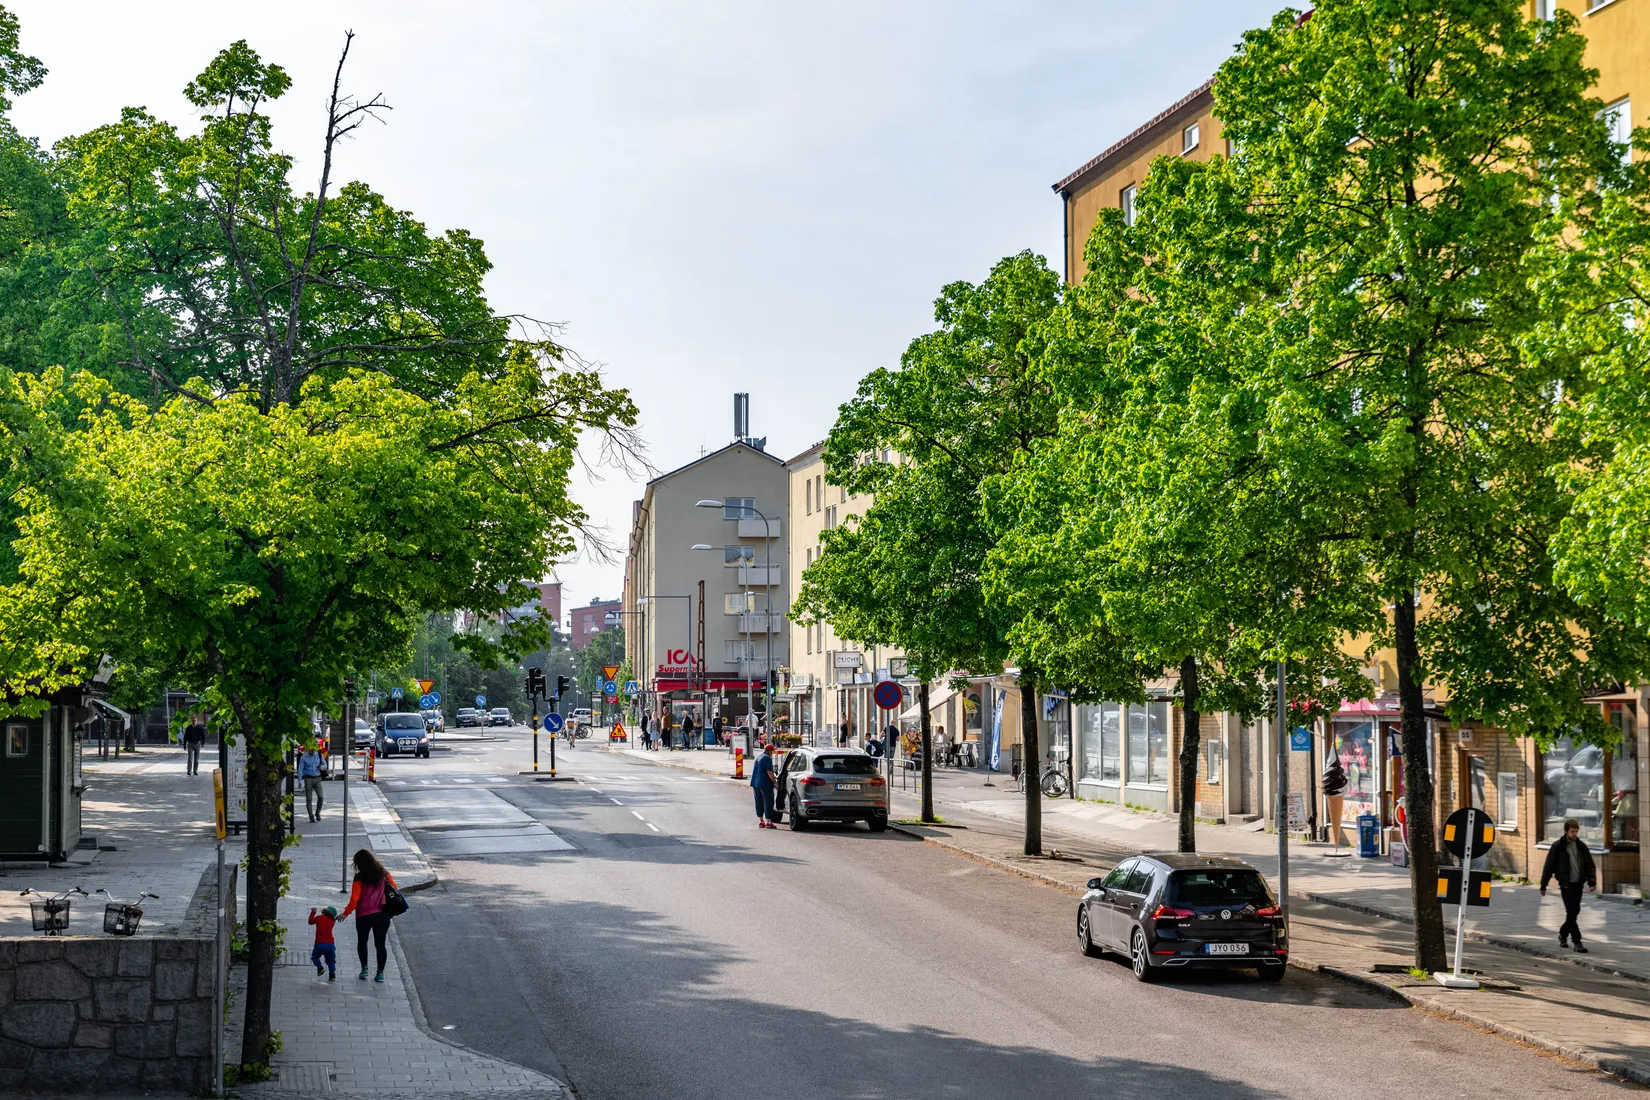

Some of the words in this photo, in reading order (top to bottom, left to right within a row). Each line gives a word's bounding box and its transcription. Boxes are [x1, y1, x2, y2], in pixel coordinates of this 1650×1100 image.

[667, 649, 697, 665] ICA
[1212, 944, 1228, 952] JYO
[1230, 944, 1246, 952] 036
